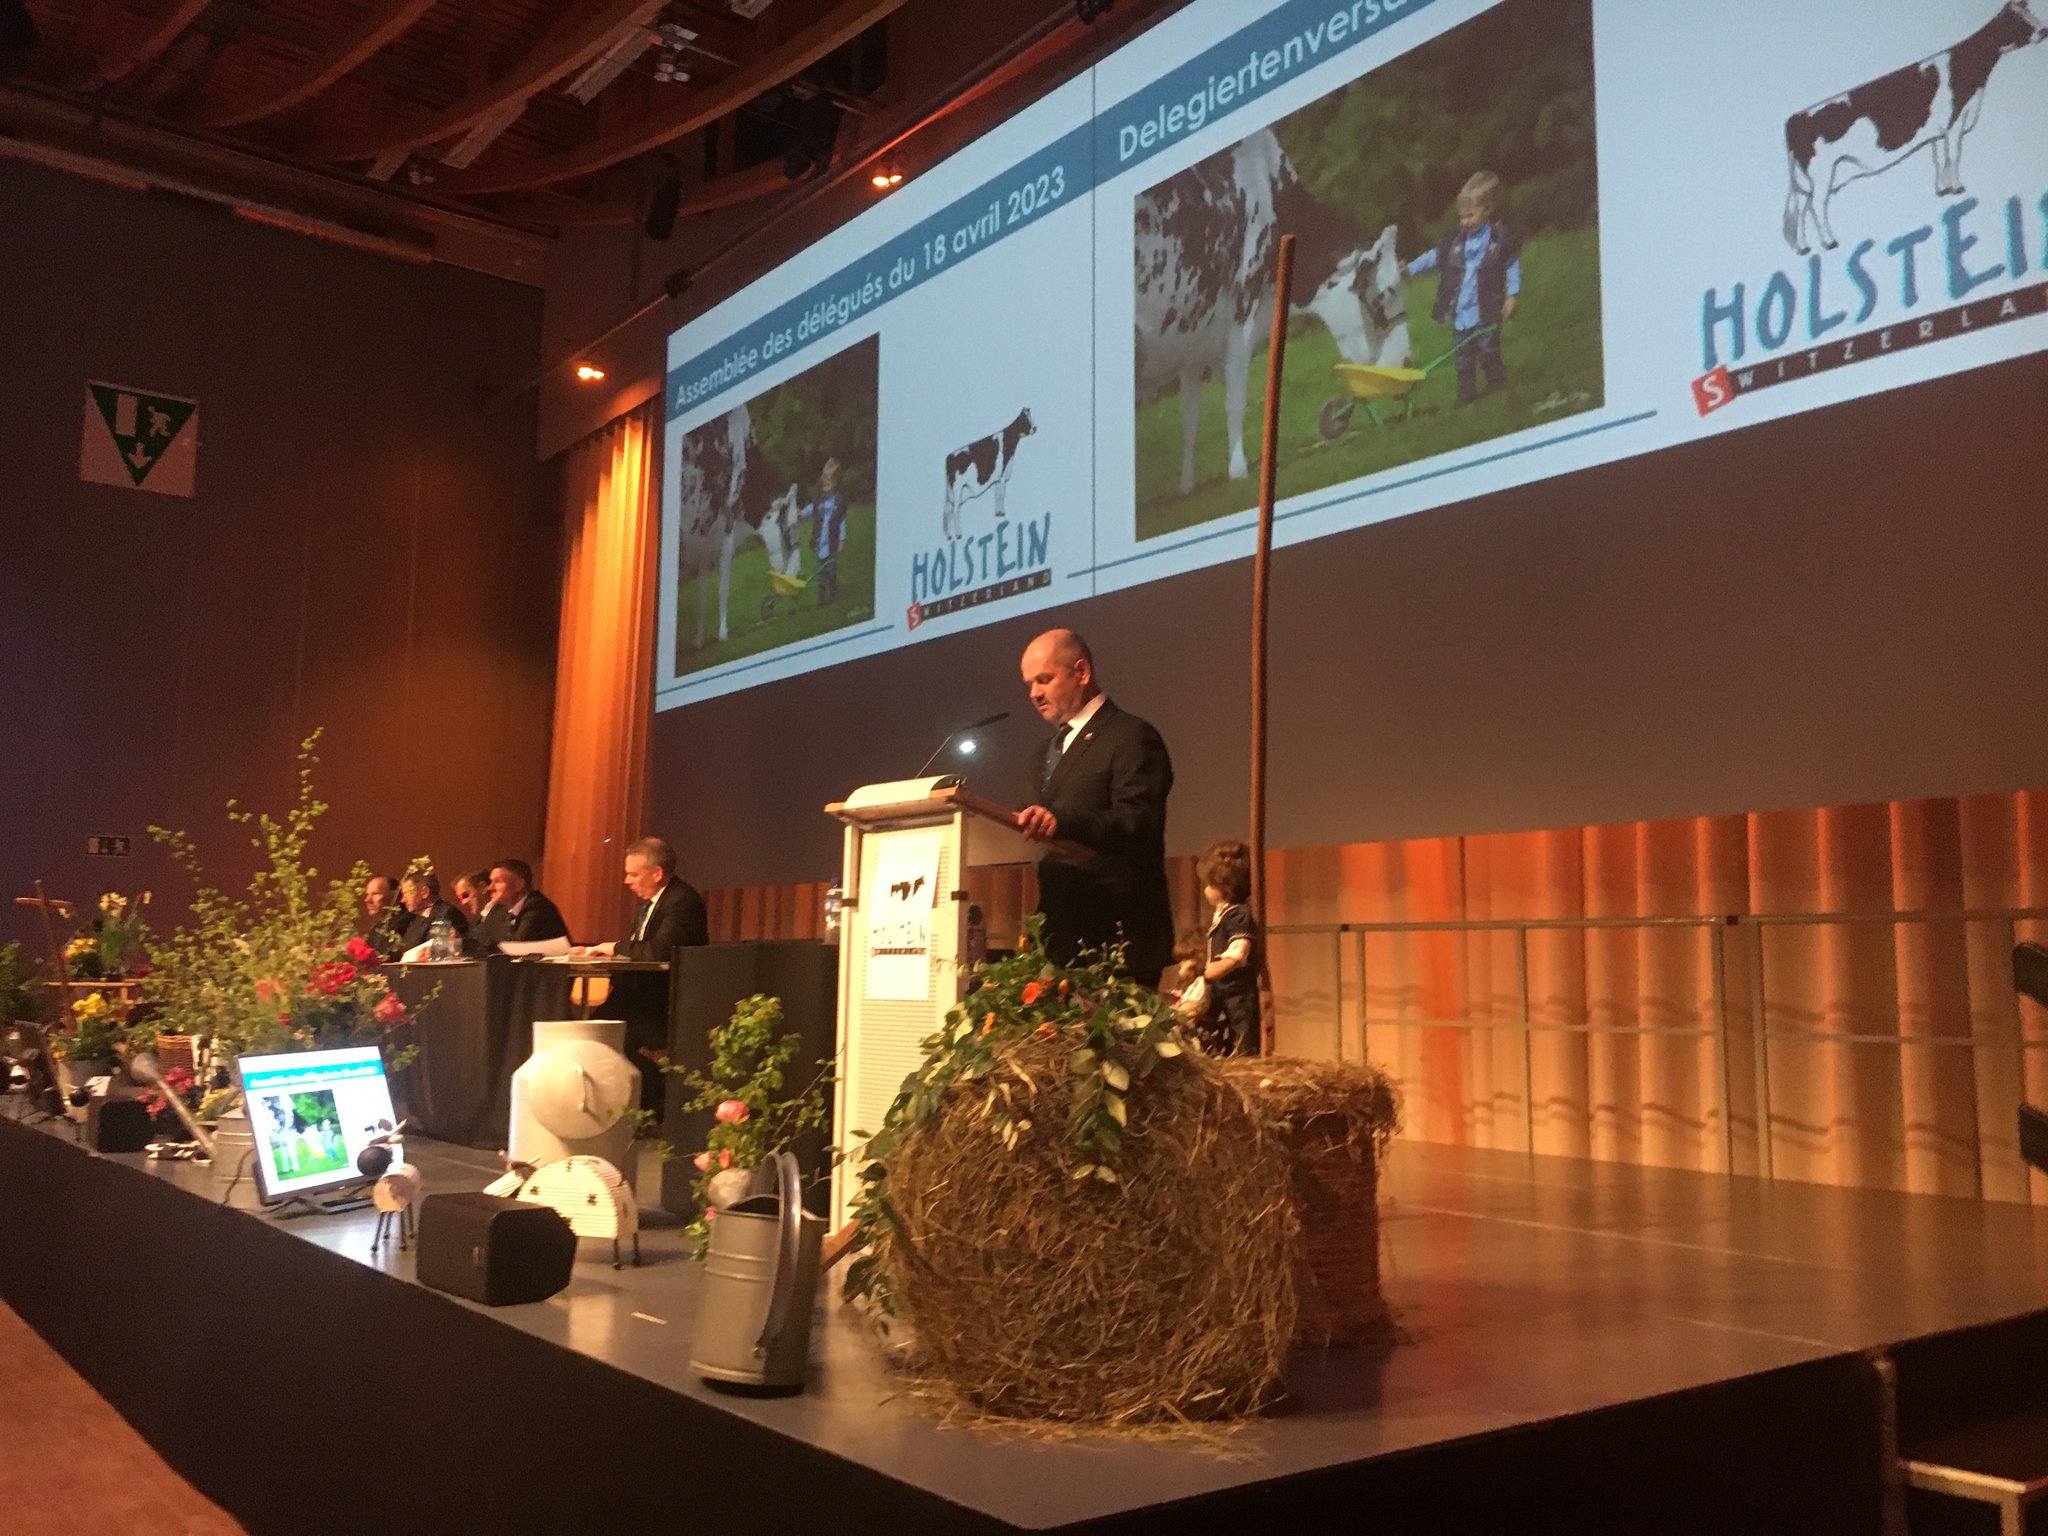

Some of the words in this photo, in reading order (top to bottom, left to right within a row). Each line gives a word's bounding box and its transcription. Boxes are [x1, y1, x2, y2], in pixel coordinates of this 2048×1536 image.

[675, 347, 758, 409] Assemblée
[763, 330, 792, 361] des
[797, 266, 883, 340] délégués
[889, 256, 915, 288] du
[923, 238, 946, 271] 18
[953, 206, 1000, 254] avril
[1007, 165, 1065, 223] 2023
[1701, 288, 2048, 408] SWITZERLA
[908, 570, 1050, 627] SWITZERLAND
[911, 511, 1051, 603] HOLSTEIN
